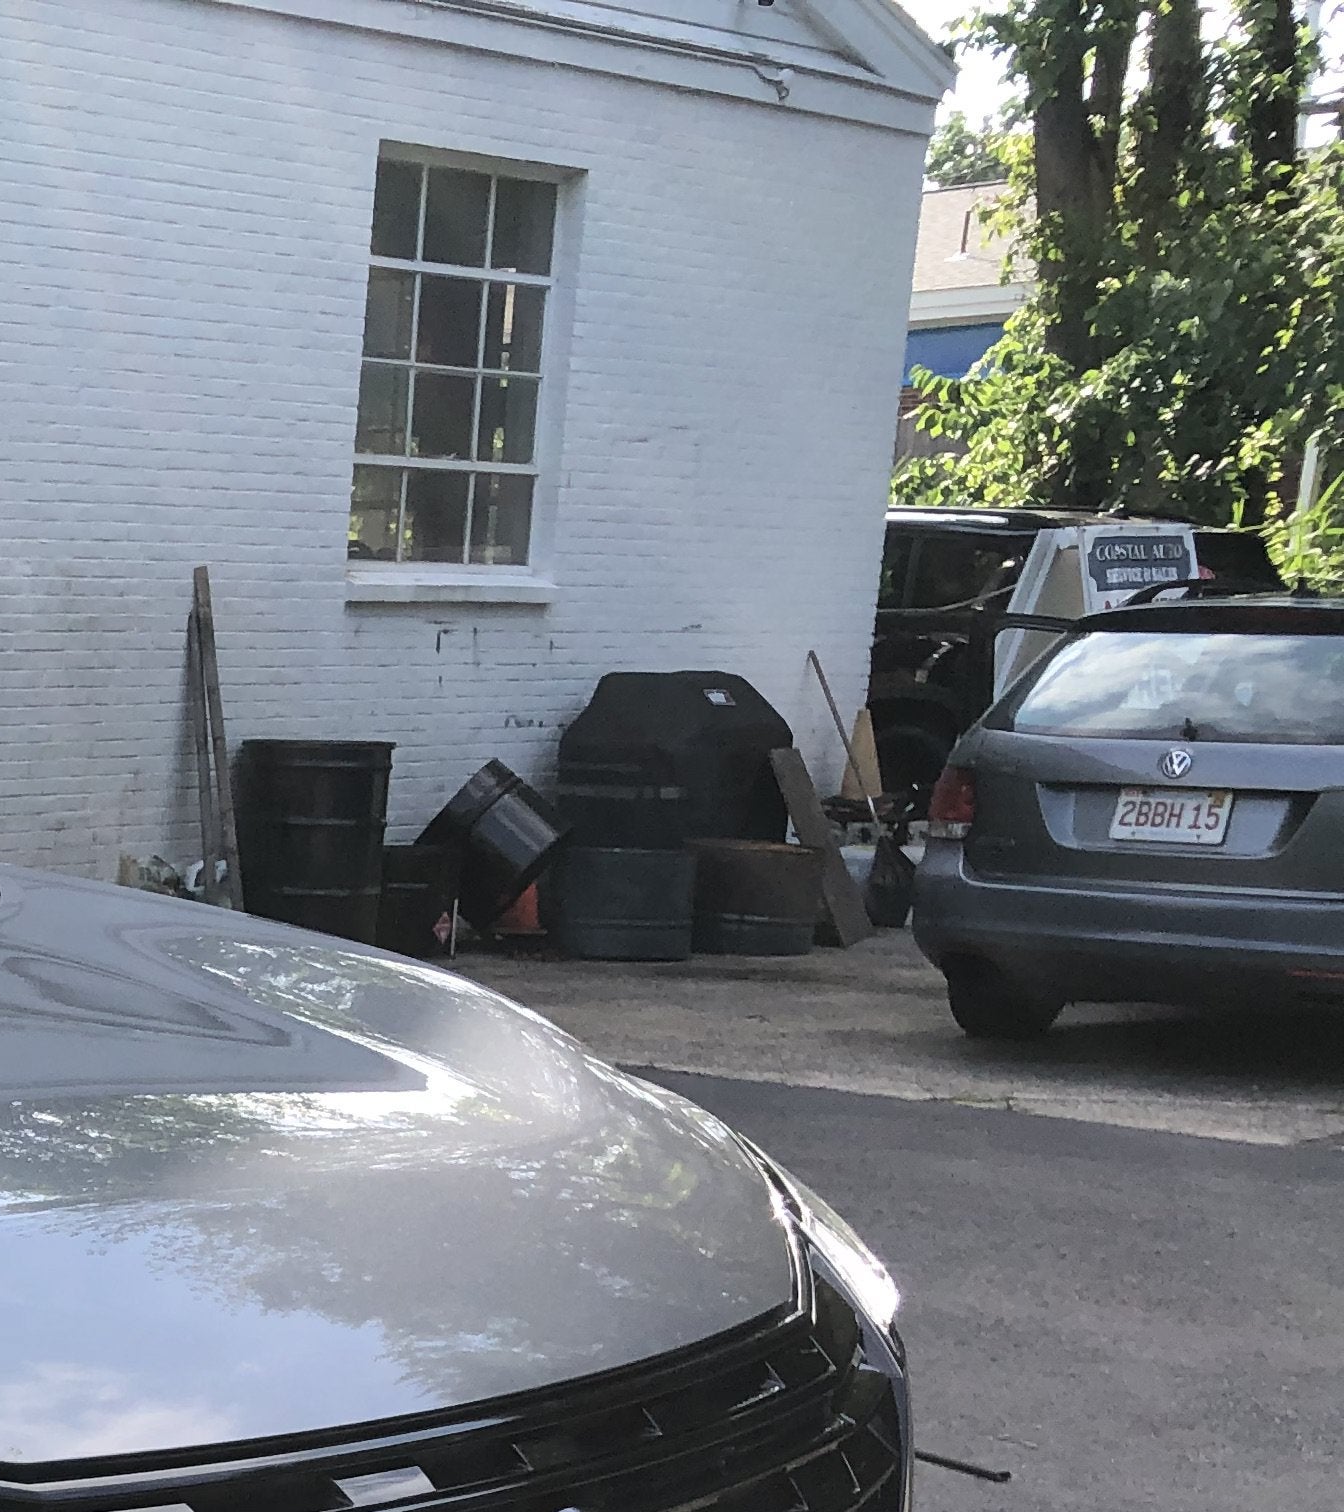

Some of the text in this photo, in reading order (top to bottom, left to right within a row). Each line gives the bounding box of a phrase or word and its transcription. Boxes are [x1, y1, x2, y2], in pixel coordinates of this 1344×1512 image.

[1095, 543, 1148, 561] COASTAL
[1118, 801, 1220, 831] 2BBH 15
